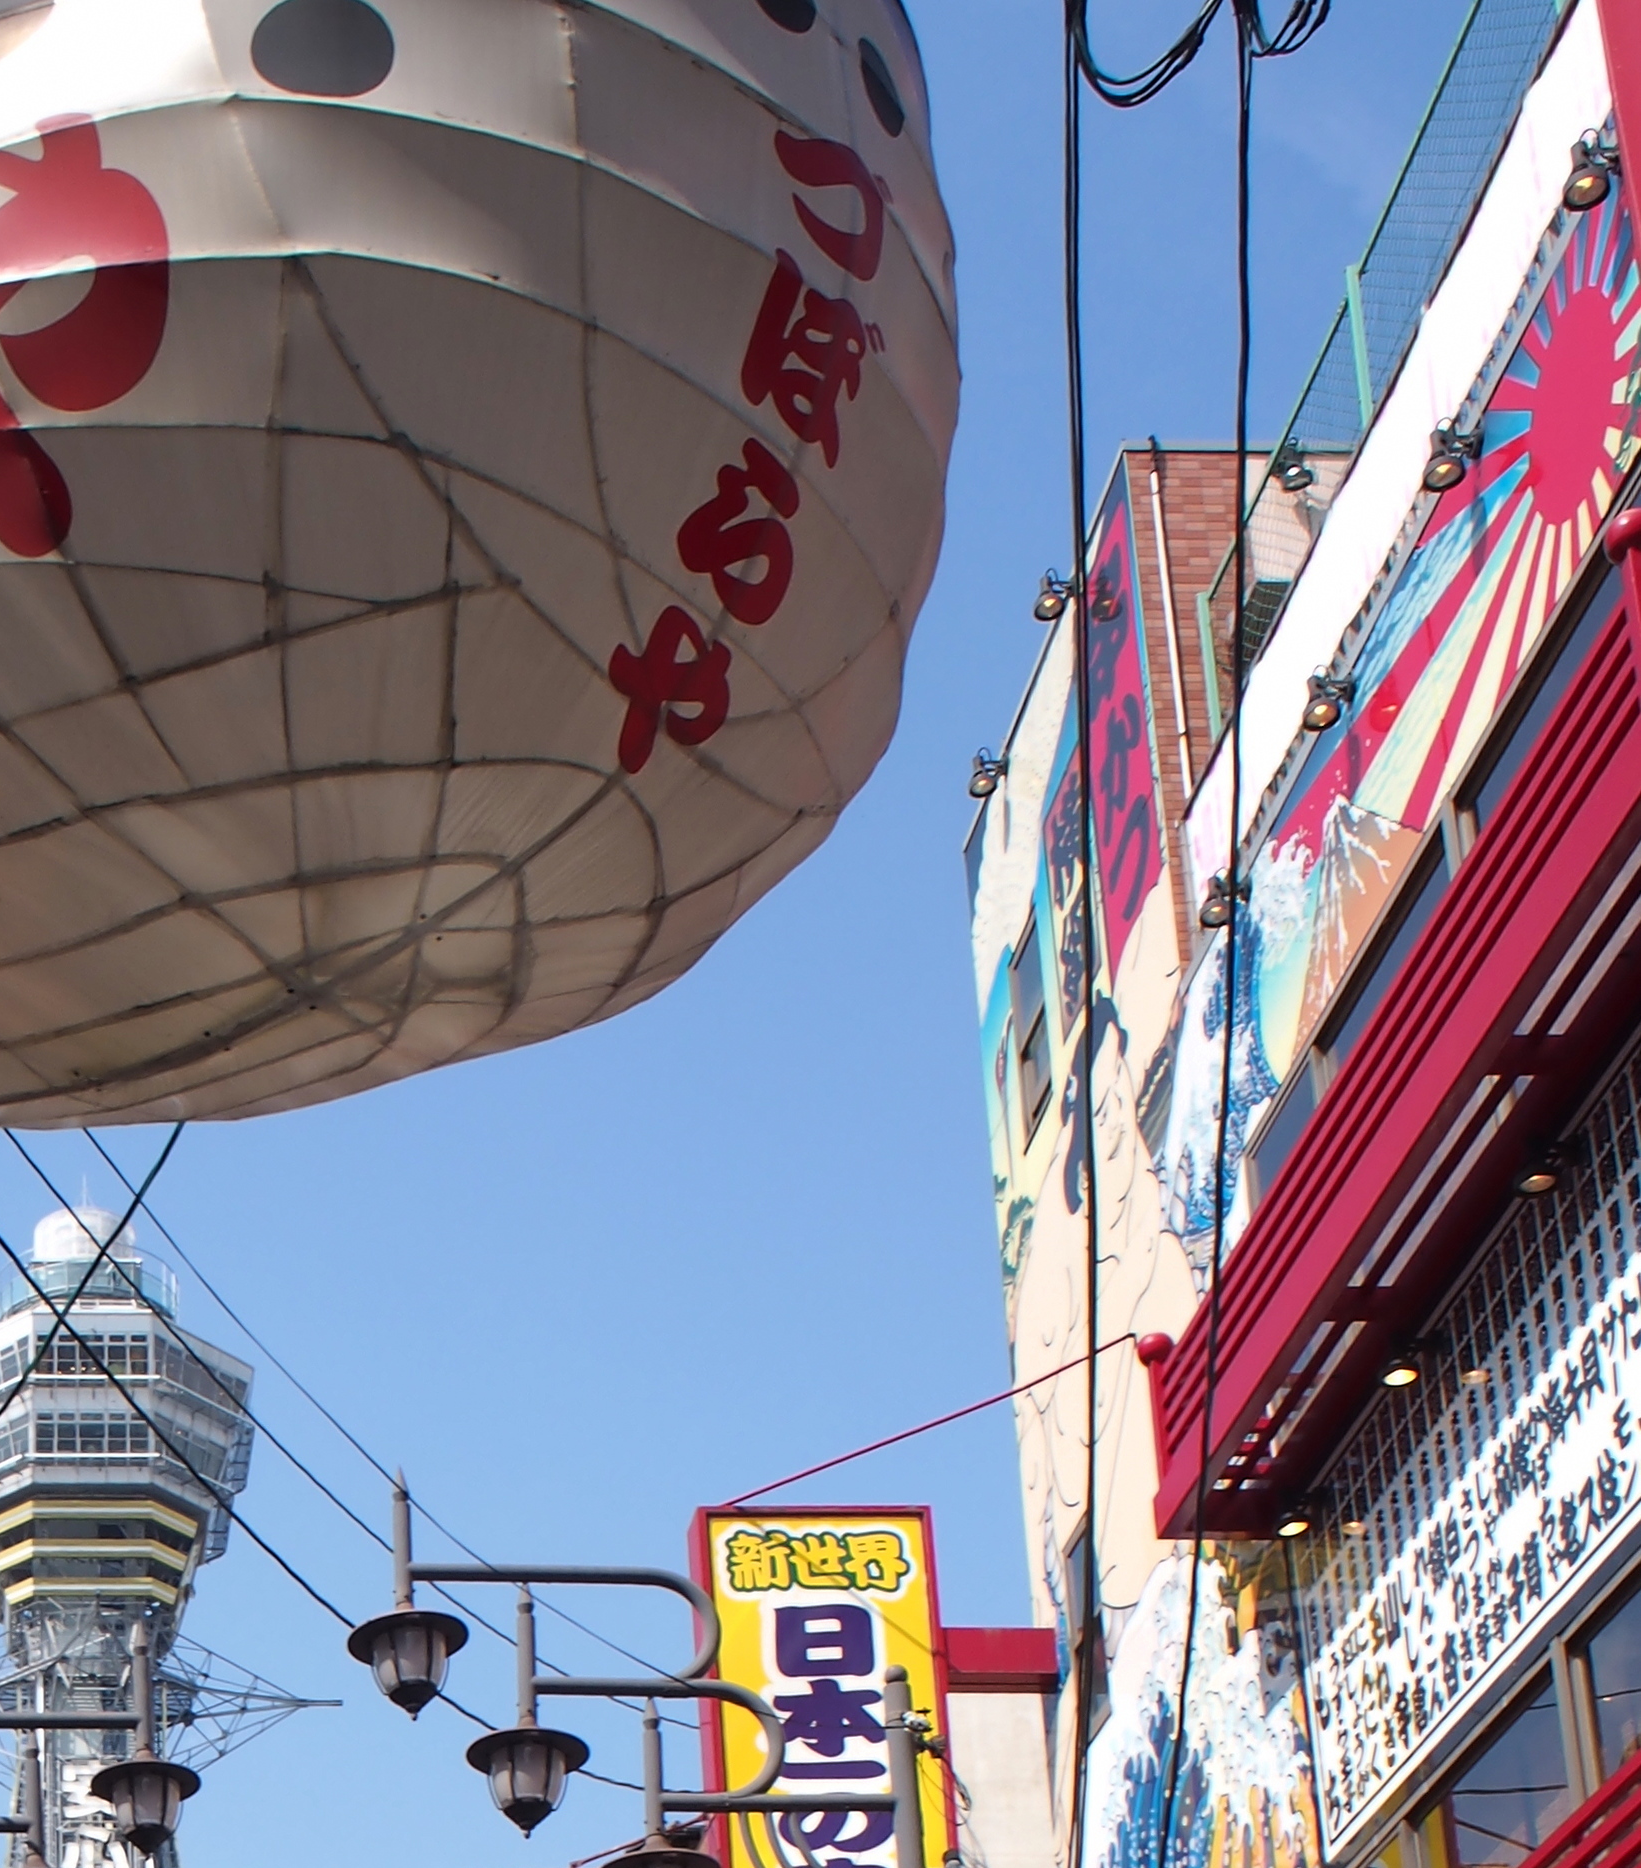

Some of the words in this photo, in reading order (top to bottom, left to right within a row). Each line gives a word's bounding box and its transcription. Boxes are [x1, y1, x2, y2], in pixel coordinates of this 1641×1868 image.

[609, 129, 892, 776] づぼらや
[726, 1530, 911, 1593] 新世界
